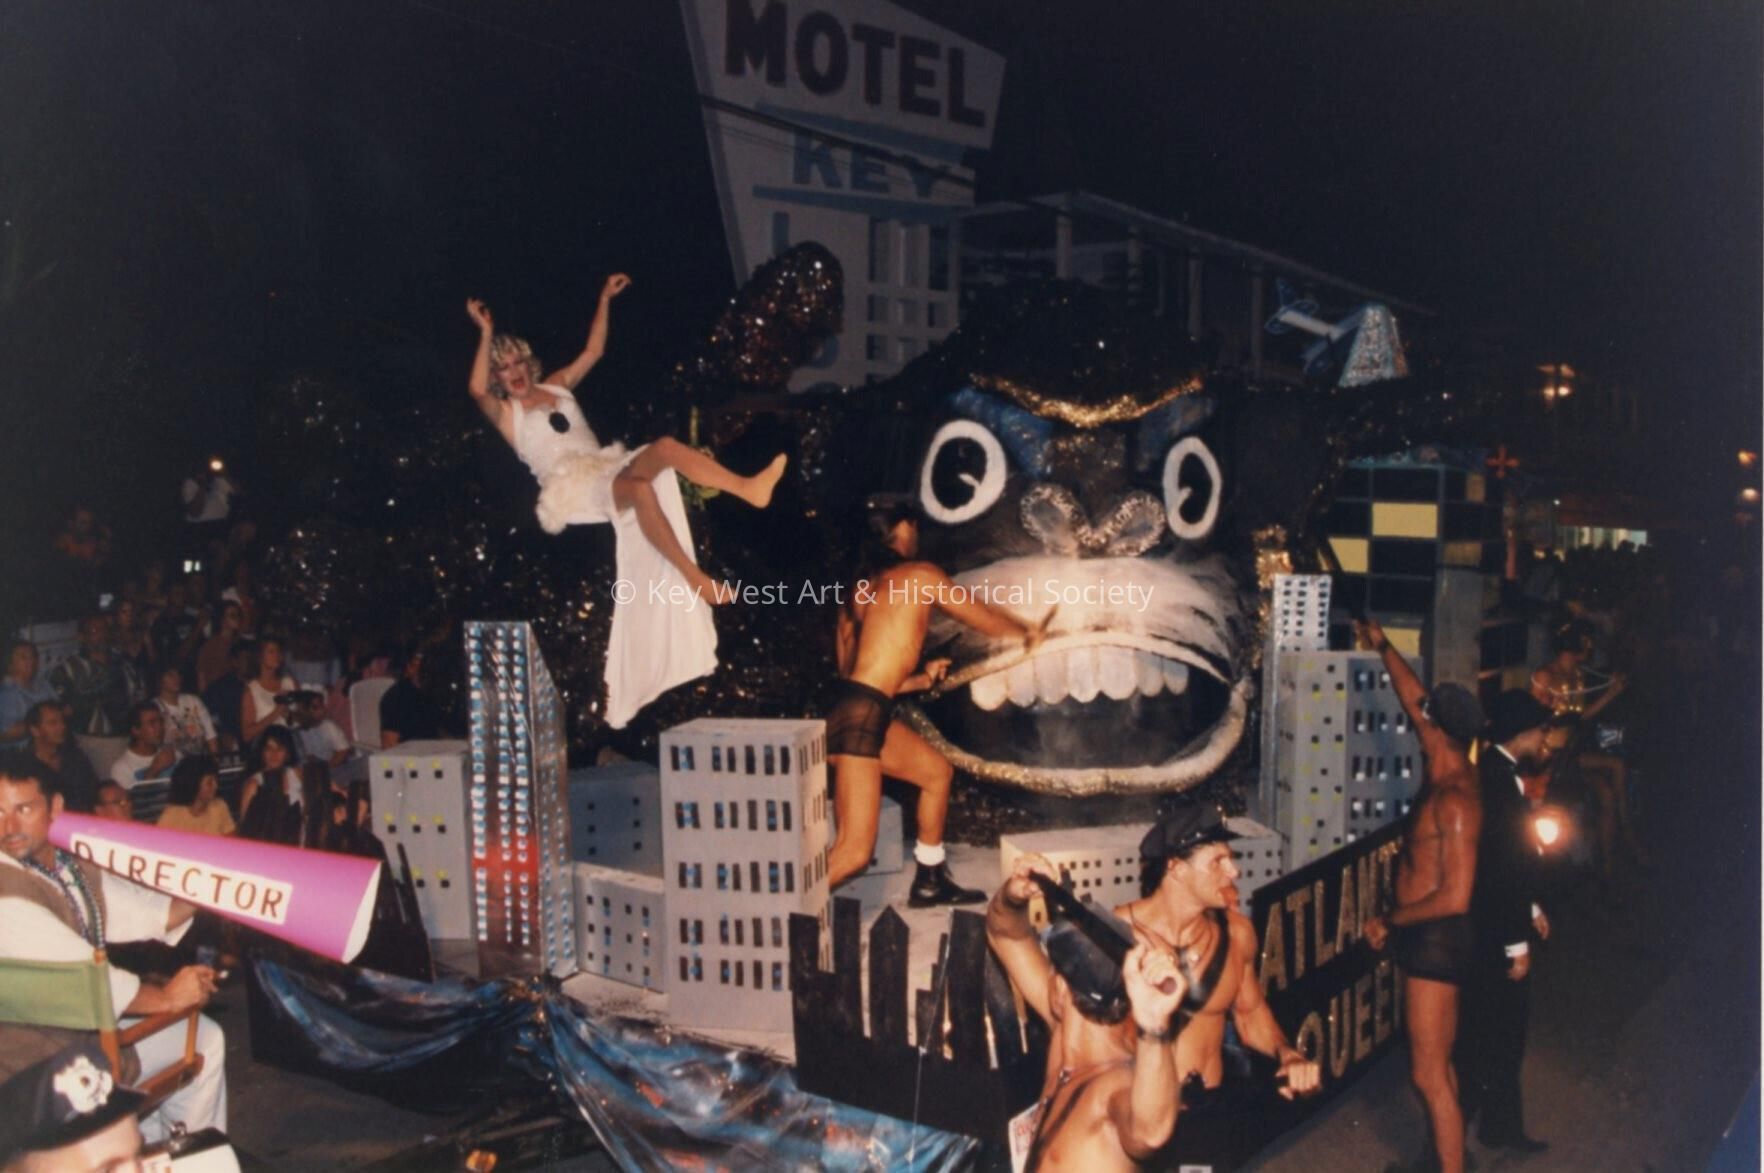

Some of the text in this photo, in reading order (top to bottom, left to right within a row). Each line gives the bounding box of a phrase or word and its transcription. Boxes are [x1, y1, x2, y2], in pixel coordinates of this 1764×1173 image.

[725, 0, 985, 128] MOTEL
[794, 131, 950, 197] KEY
[75, 840, 283, 918] DIRECTOR
[1260, 836, 1403, 1000] ATLANT
